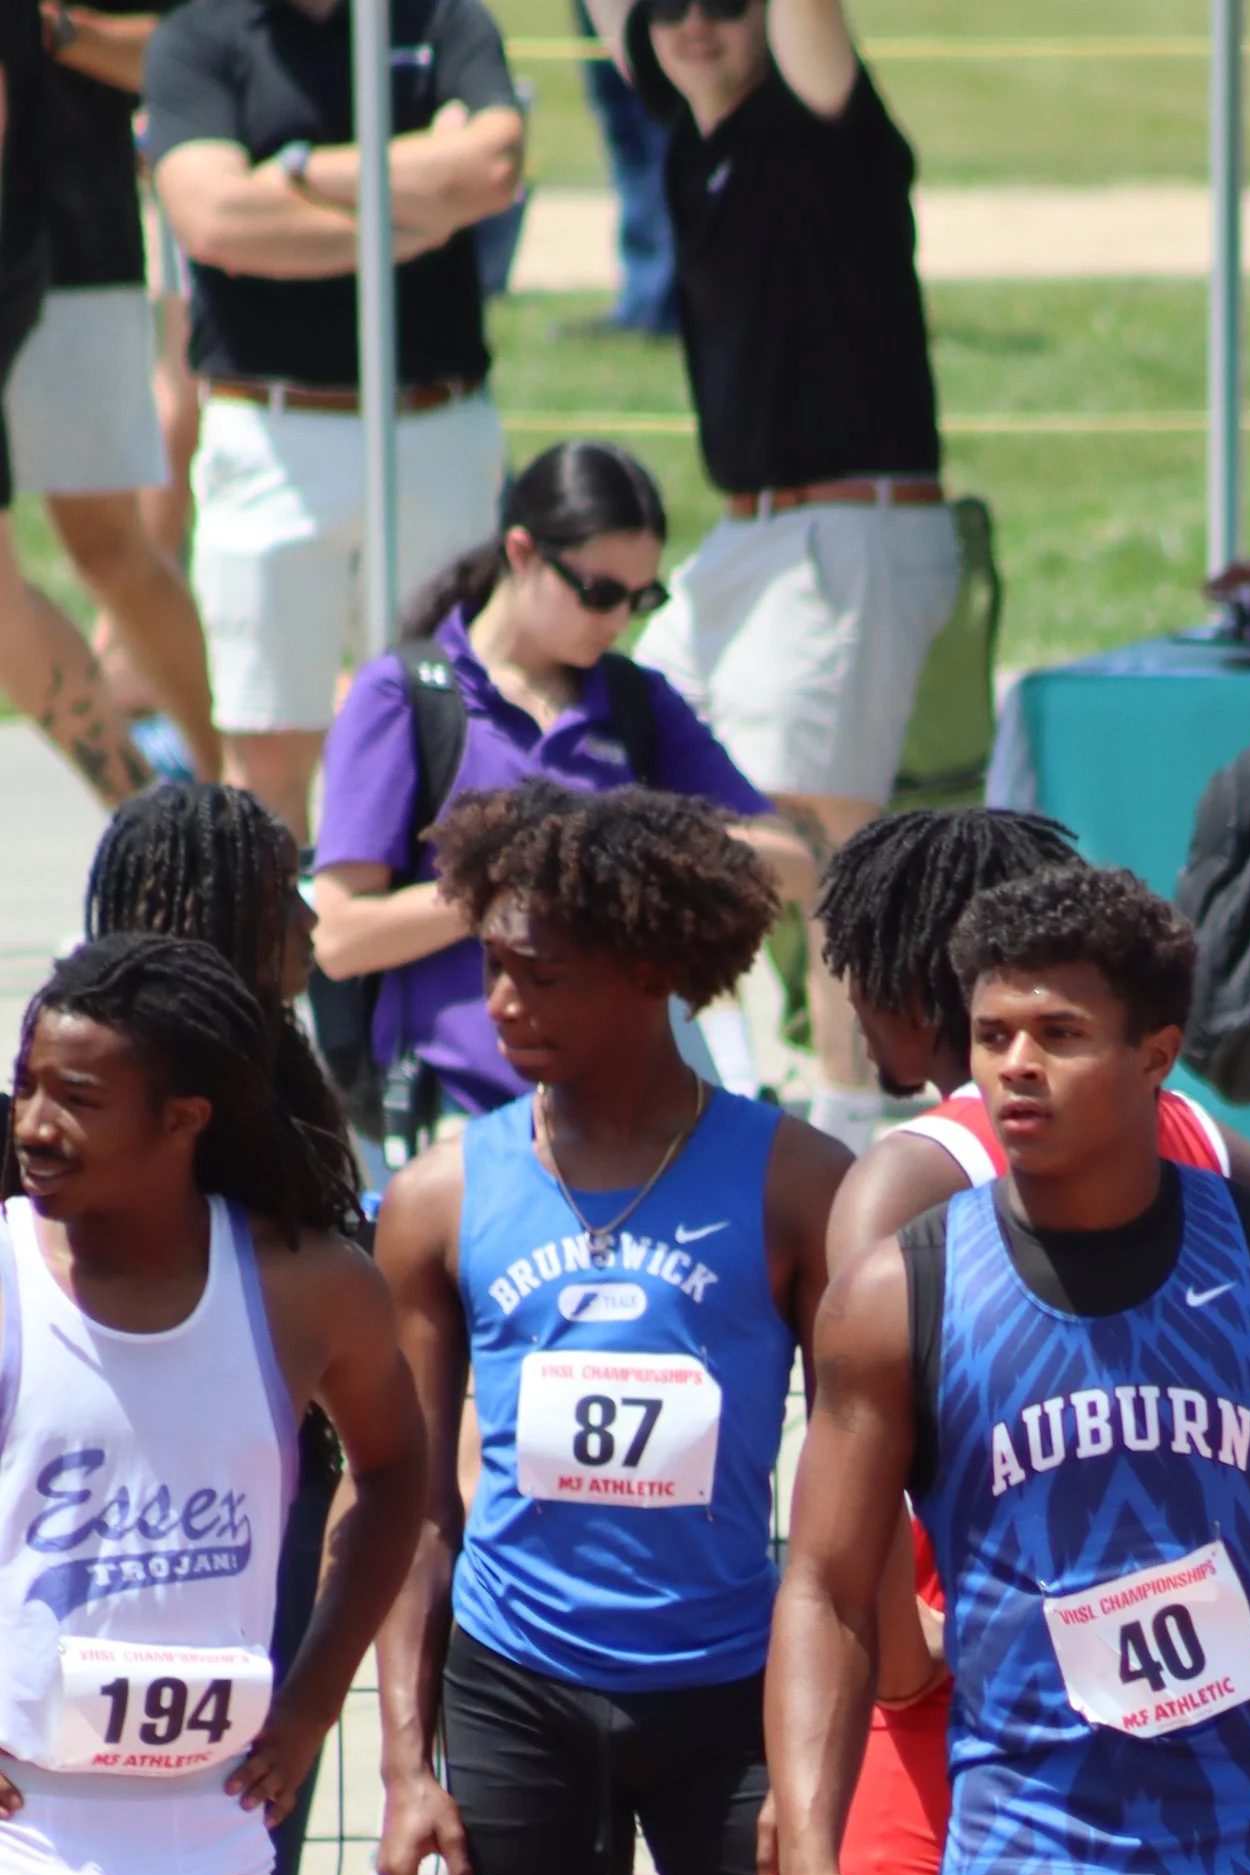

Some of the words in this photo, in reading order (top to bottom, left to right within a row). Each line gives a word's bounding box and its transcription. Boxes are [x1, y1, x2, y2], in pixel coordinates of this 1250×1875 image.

[488, 1231, 718, 1316] BRUNSWICK
[582, 1364, 703, 1385] CHAMPIONSHIPS
[572, 1394, 663, 1468] 87
[26, 1448, 248, 1553] Essex
[588, 1476, 675, 1496] ATHLETIC
[1059, 1604, 1097, 1625] VHSL
[1100, 1559, 1217, 1615] CHAMPIONSHIPS
[1119, 1603, 1206, 1692] 40
[100, 1677, 232, 1745] 194
[1154, 1676, 1235, 1722] ATHLETIC
[122, 1751, 214, 1768] ATHLETIC
